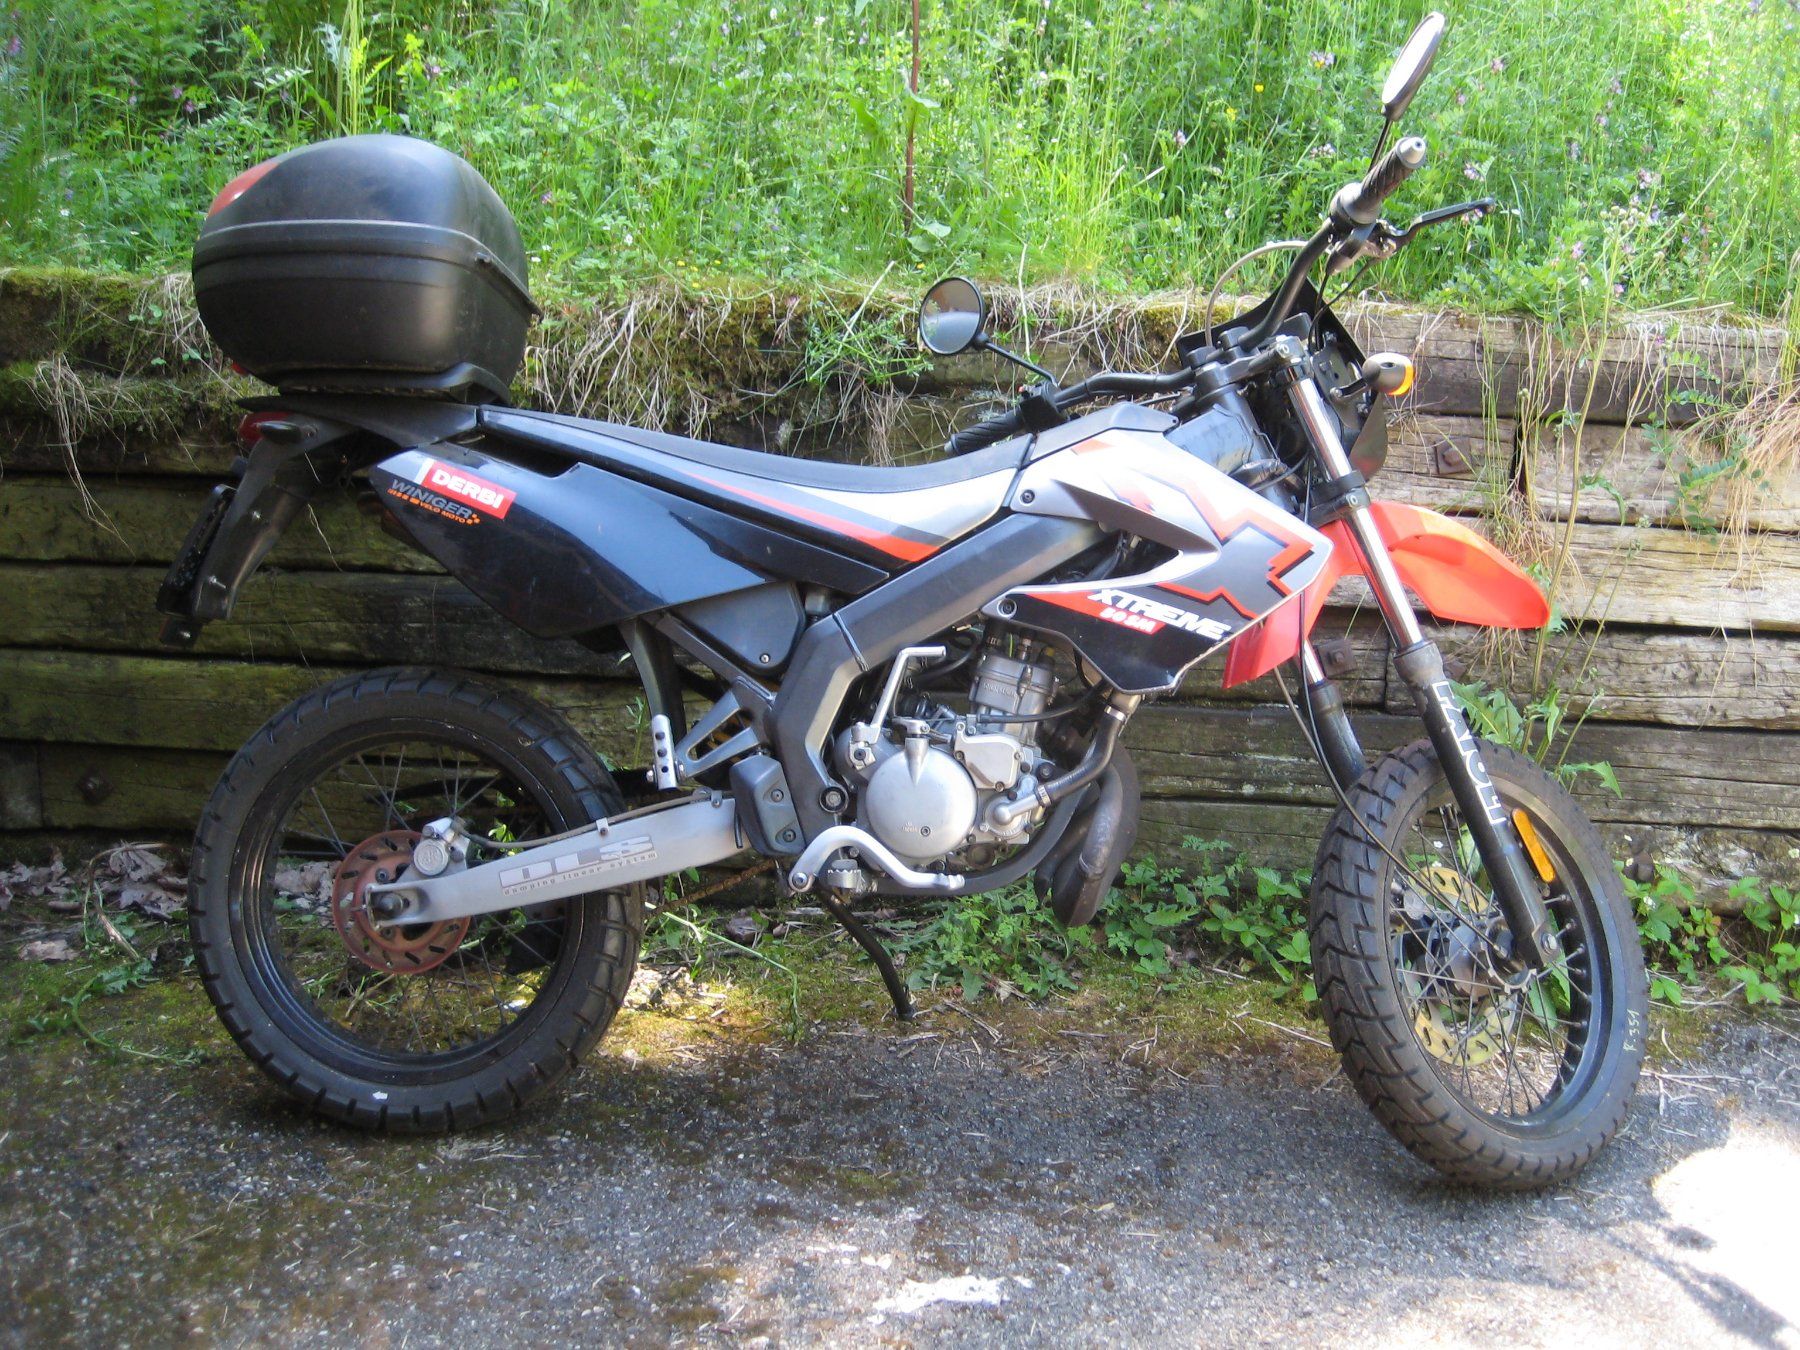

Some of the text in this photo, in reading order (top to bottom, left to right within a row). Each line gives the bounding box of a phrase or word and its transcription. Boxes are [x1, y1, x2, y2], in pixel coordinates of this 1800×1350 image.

[391, 478, 473, 519] WINIGER
[431, 468, 504, 509] DERBI
[420, 501, 466, 524] VELO MOTO
[1087, 588, 1232, 641] XTREME
